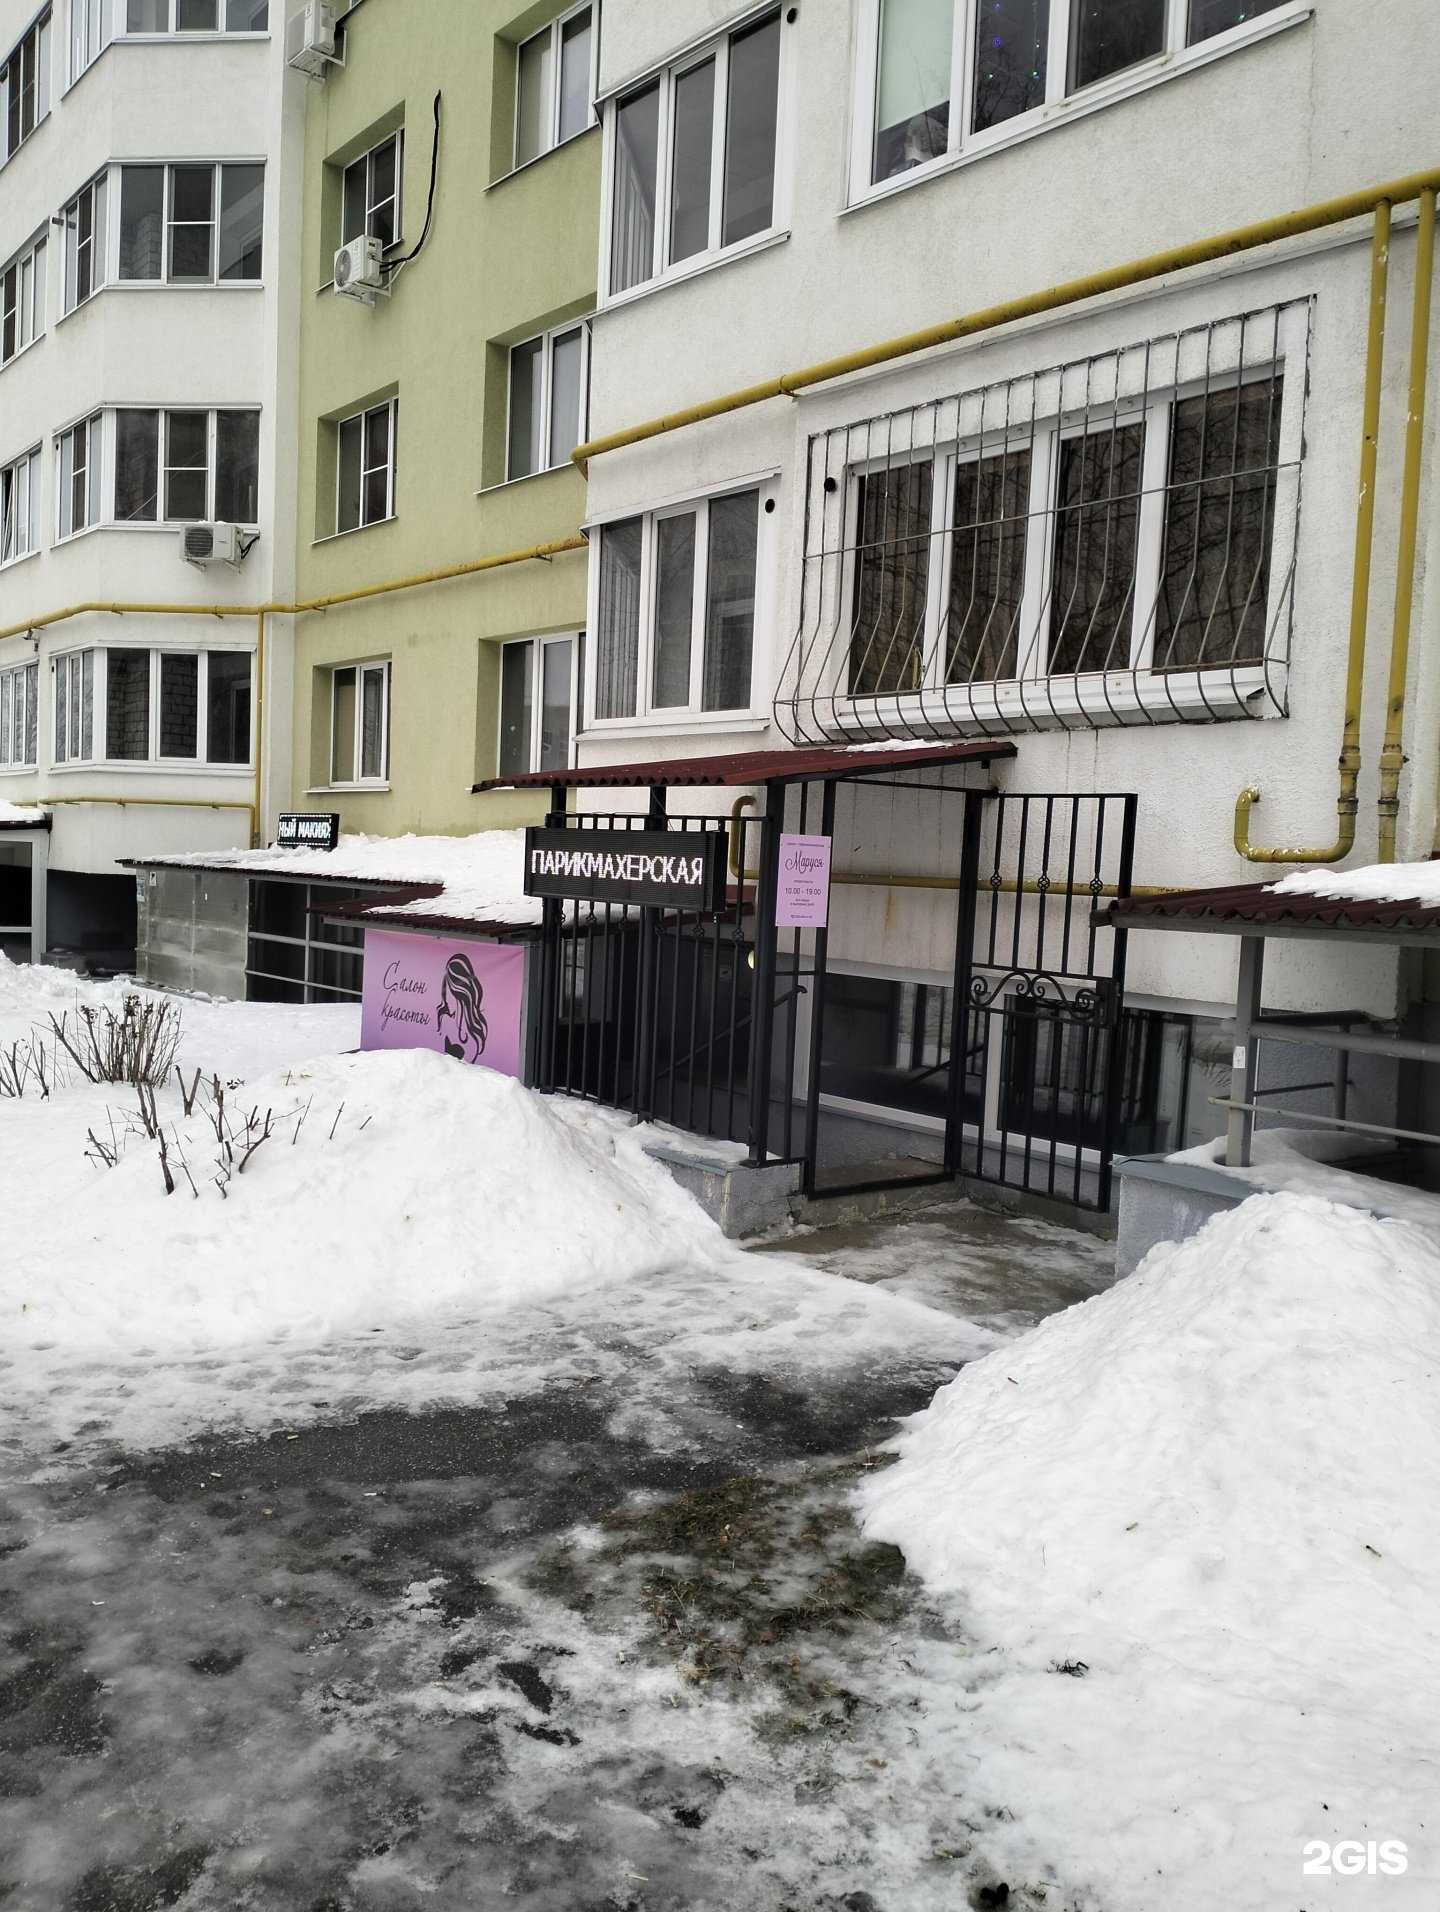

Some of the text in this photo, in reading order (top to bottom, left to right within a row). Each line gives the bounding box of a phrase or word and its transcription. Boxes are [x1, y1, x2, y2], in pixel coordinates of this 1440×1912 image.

[531, 850, 703, 885] ПАРИКМАХЕРСКАЯ
[785, 850, 824, 874] Маруся
[383, 961, 427, 994] Салон
